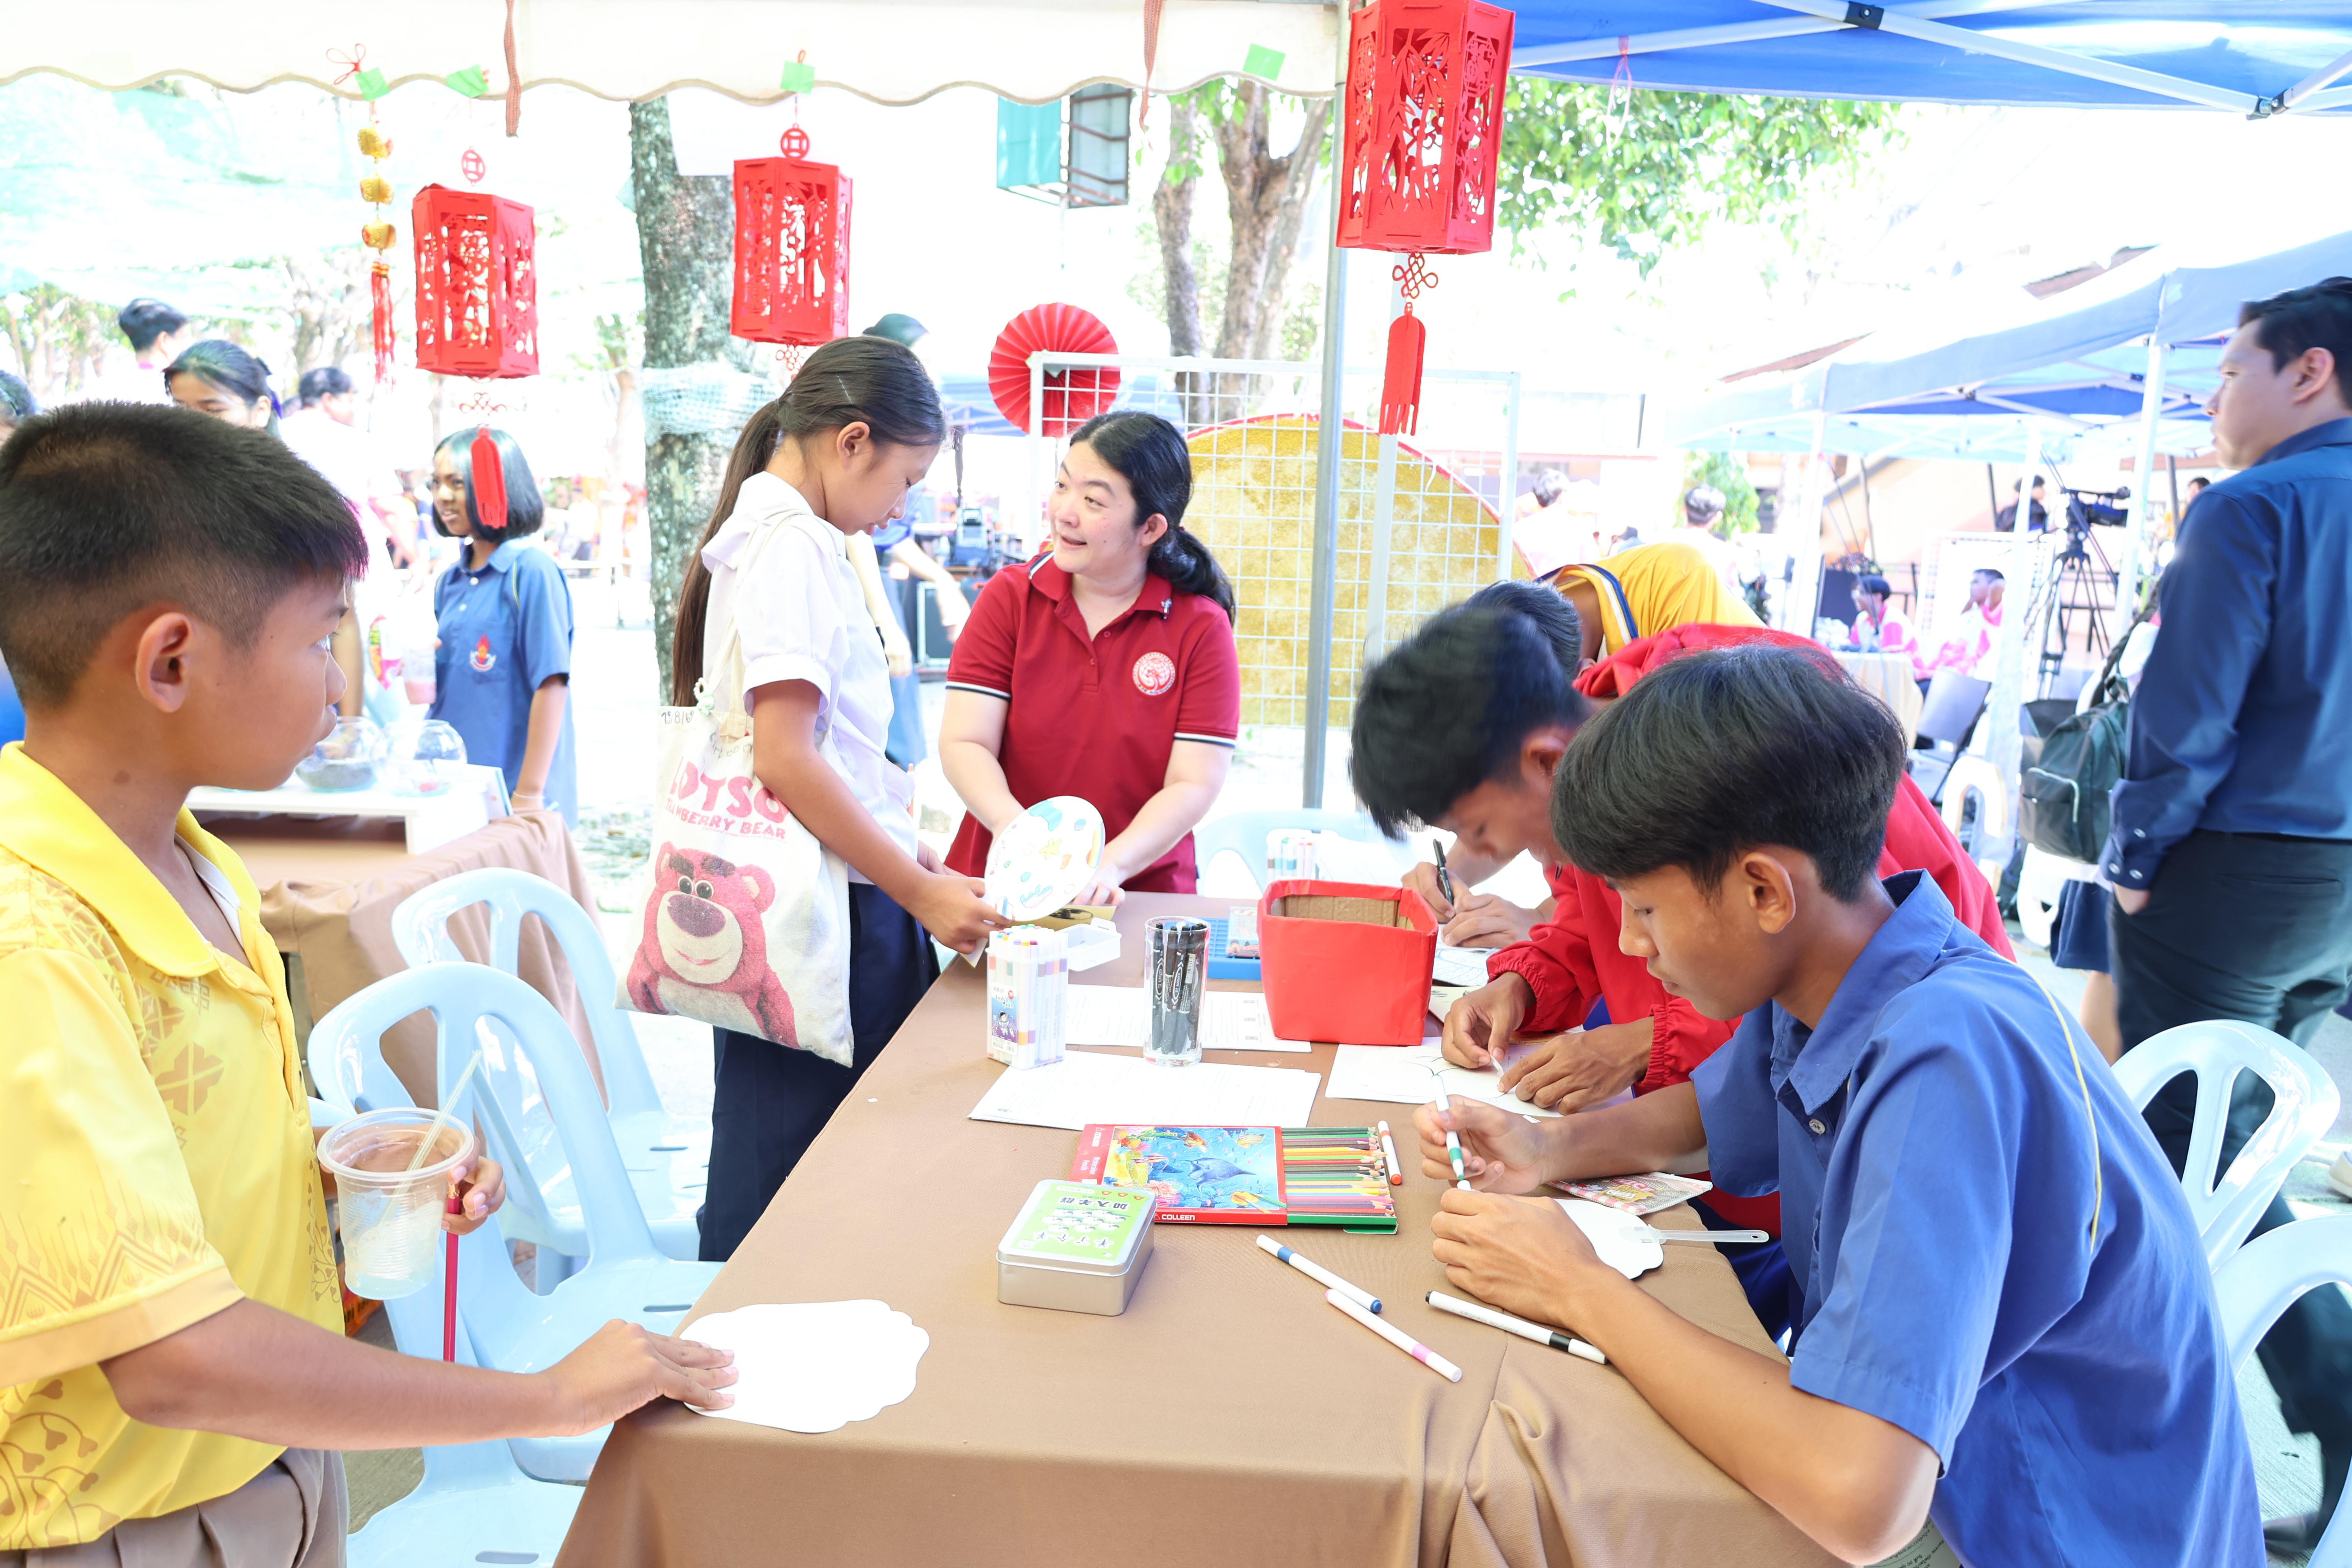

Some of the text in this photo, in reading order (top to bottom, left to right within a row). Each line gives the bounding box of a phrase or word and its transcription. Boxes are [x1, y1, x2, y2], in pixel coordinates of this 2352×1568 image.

[664, 798, 786, 839] TRAWBERRY BEAR
[1091, 1132, 1102, 1147] COLLEEN
[1059, 1197, 1128, 1210] 加入羊群
[1034, 1230, 1112, 1247] 羊了个羊
